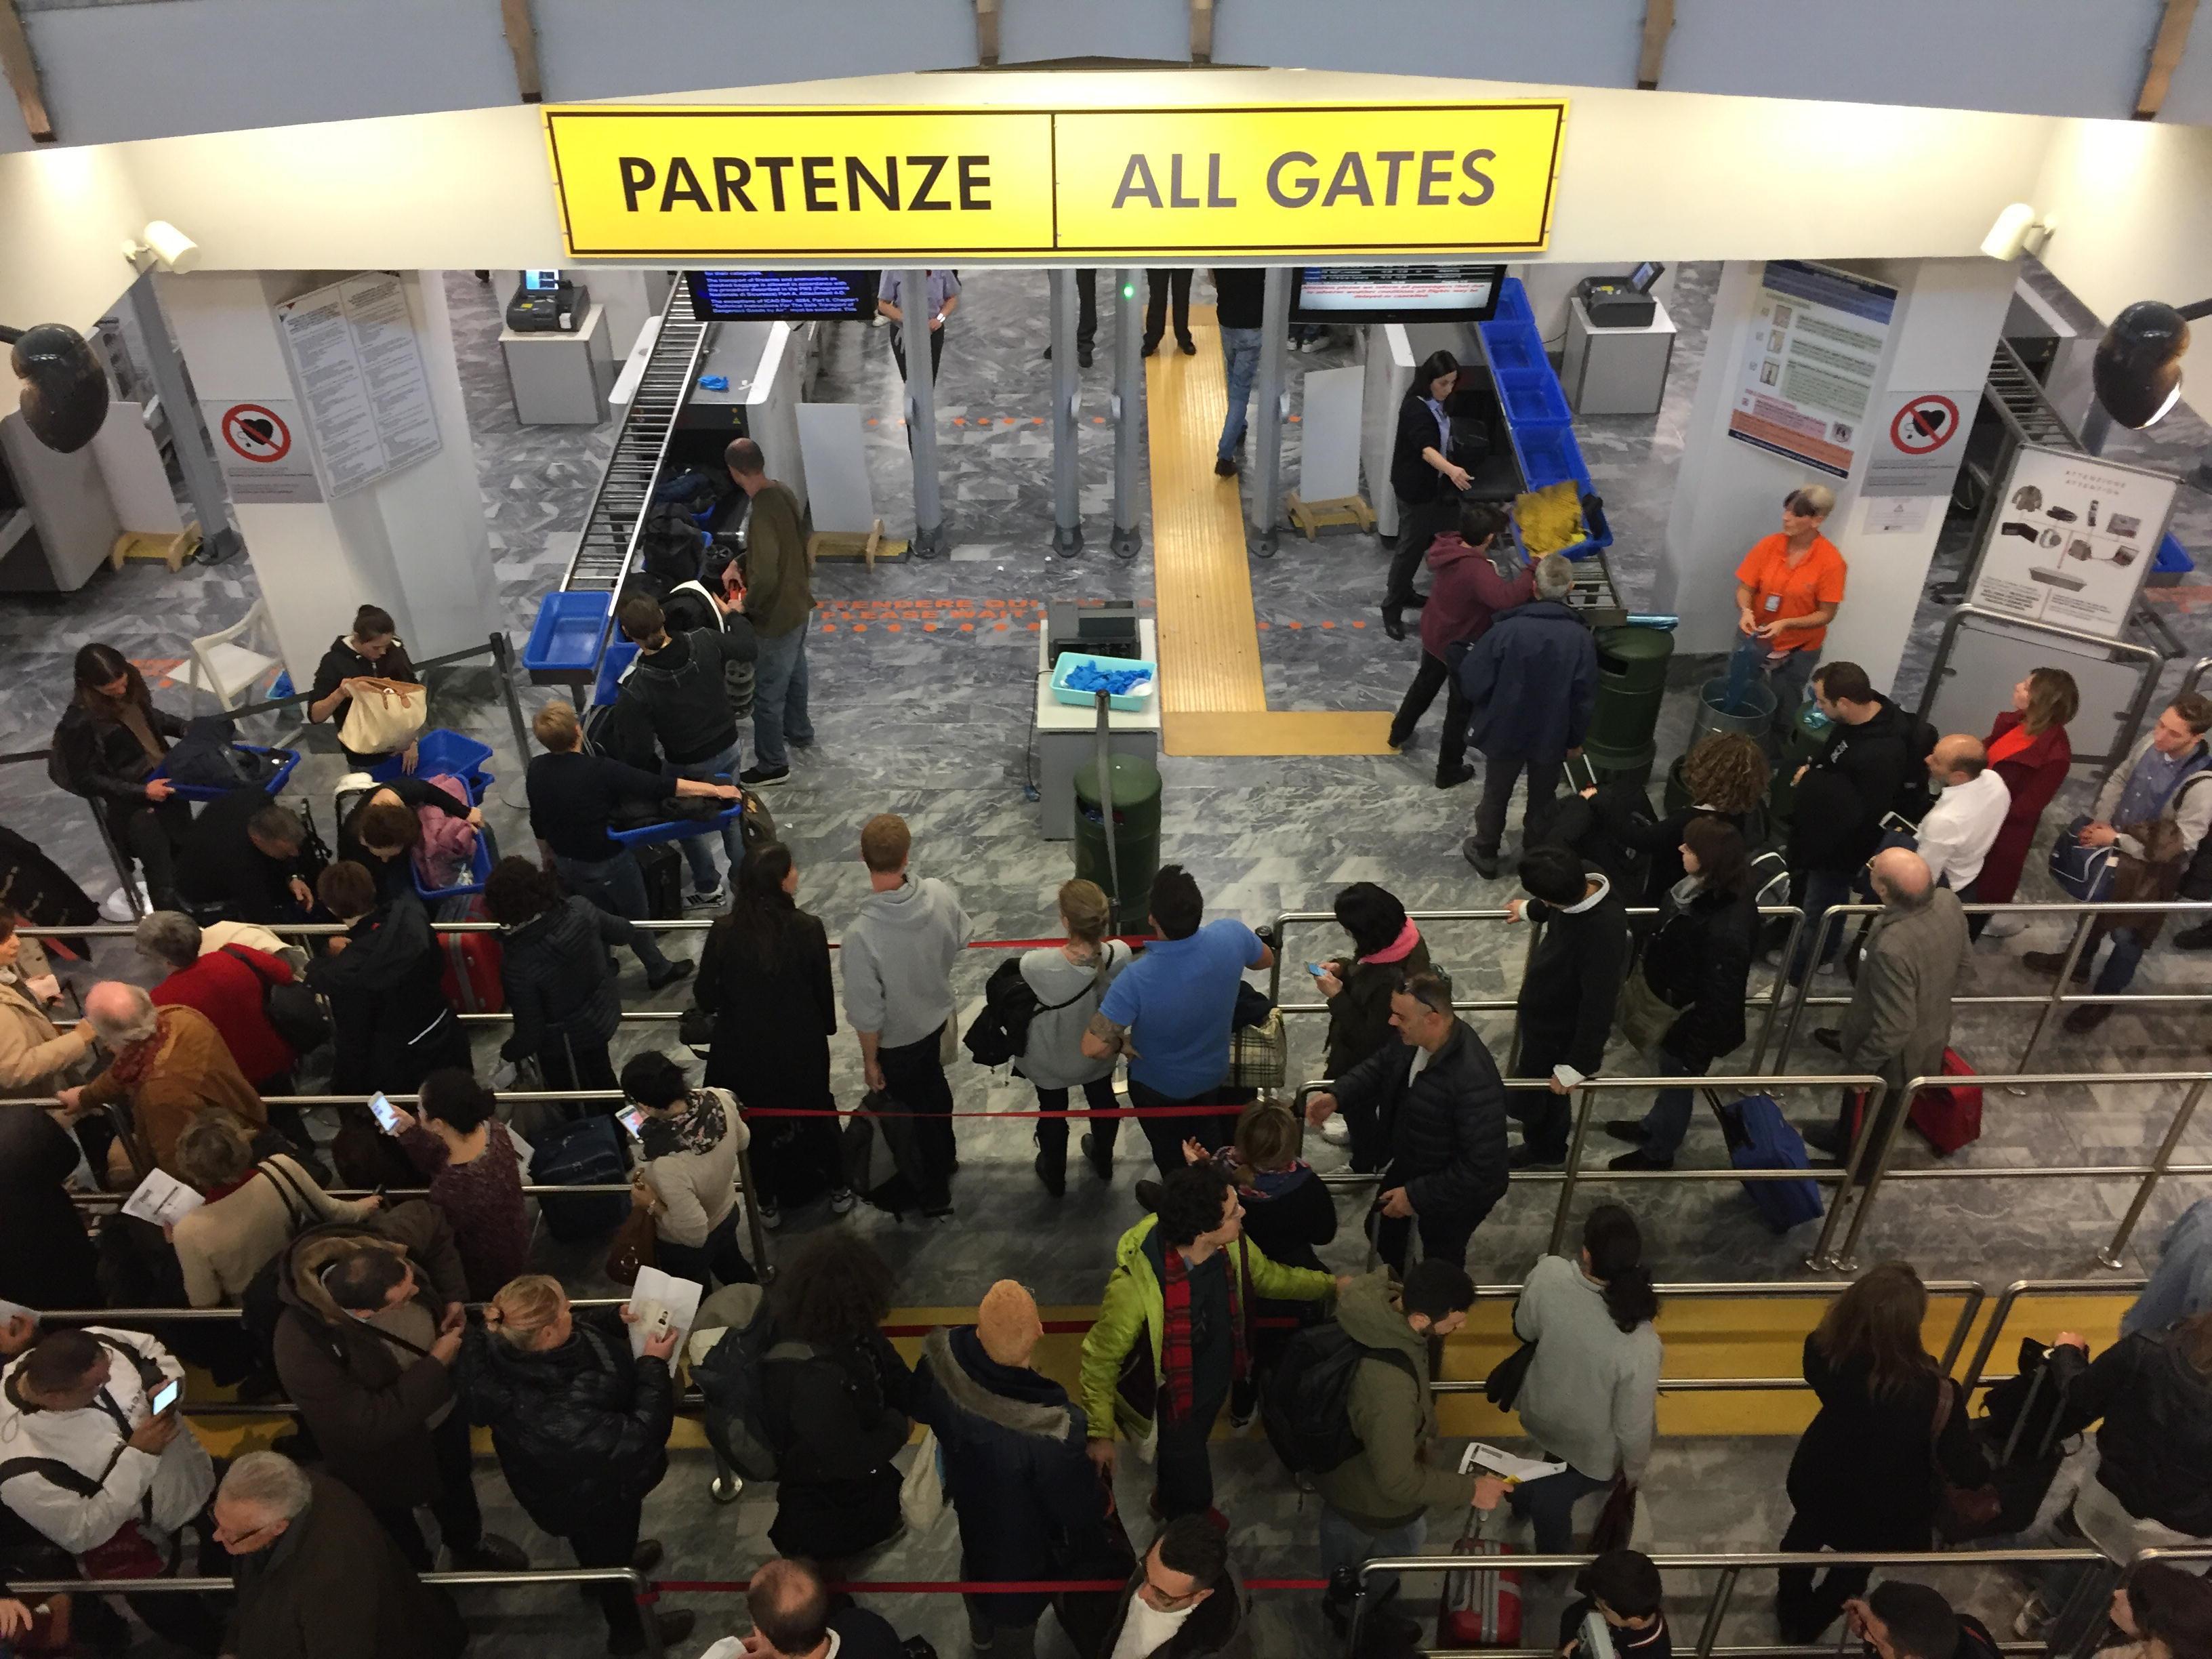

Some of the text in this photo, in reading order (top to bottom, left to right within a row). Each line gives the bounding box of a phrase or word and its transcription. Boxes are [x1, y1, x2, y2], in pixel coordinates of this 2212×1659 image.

[619, 156, 991, 211] PARTENZE
[1112, 149, 1496, 208] ALL GATES
[816, 599, 974, 610] TTENDERE
[821, 610, 939, 619] PLEASE
[950, 609, 1027, 619] WAIT
